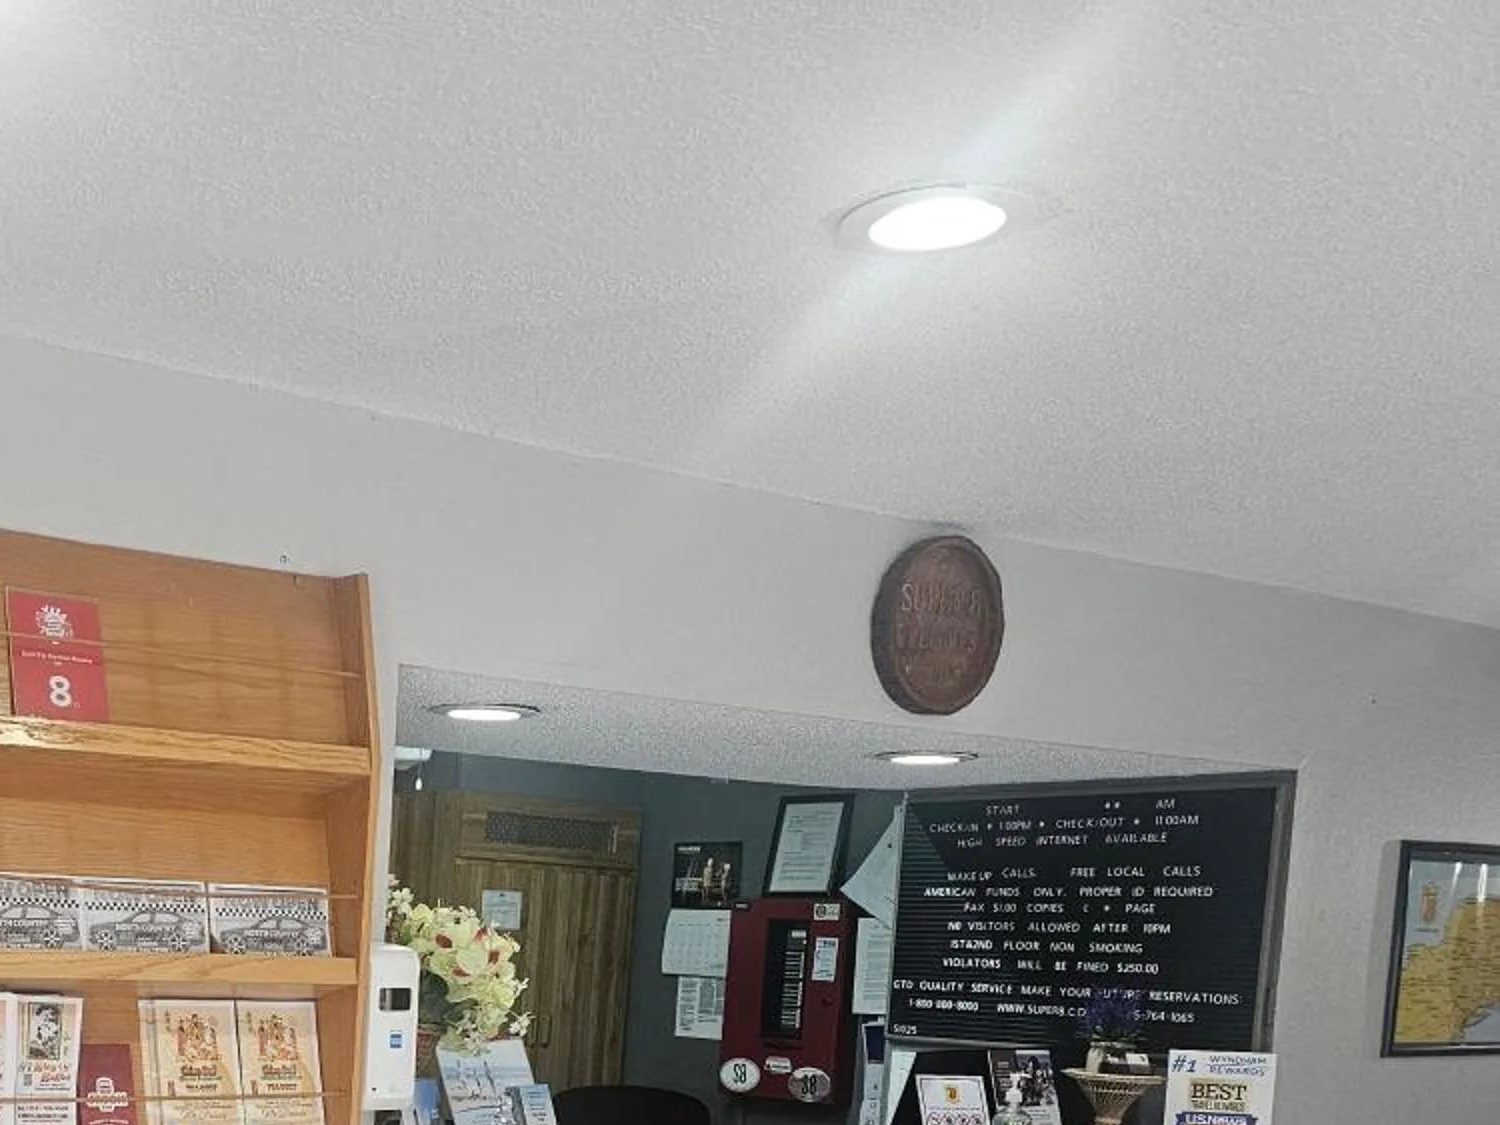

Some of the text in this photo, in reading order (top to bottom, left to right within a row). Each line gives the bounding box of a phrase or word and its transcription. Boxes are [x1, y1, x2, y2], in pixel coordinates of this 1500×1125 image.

[49, 675, 72, 707] 8
[996, 836, 1027, 847] SPEED
[1036, 835, 1089, 846] INTERNET
[1105, 832, 1168, 844] AVAILABLE
[1002, 867, 1036, 878] CALLS
[1070, 867, 1096, 877] FREE
[1107, 866, 1145, 877] LOCAL
[1163, 865, 1201, 877] CALLS
[924, 887, 976, 897] AMERICAN
[985, 887, 1021, 897] FUNDS
[1079, 887, 1122, 897] PROPER
[1132, 887, 1145, 897] ID
[1153, 887, 1214, 897] REQUIRED
[963, 902, 985, 912] FAX
[1026, 903, 1065, 912] COPIES
[1125, 903, 1156, 913] PAGE
[948, 922, 962, 931] NO
[968, 922, 1016, 931] VISITORS
[1027, 922, 1080, 933] ALLOWED
[1093, 923, 1128, 933] AFTER
[1003, 941, 1040, 951] FLOOR
[1050, 942, 1075, 952] NON
[1089, 943, 1143, 954] SMOKING
[942, 958, 1001, 969] VIOLATORS
[1017, 960, 1042, 970] WILL
[1055, 961, 1067, 971] BE
[1076, 962, 1109, 973] FINED
[919, 981, 963, 992] QUALITY
[971, 983, 1013, 995] SERVICE
[1021, 986, 1052, 997] MAKE
[1059, 987, 1091, 997] YOUR
[1172, 1055, 1197, 1073] #1
[1192, 1083, 1247, 1101] BEST
